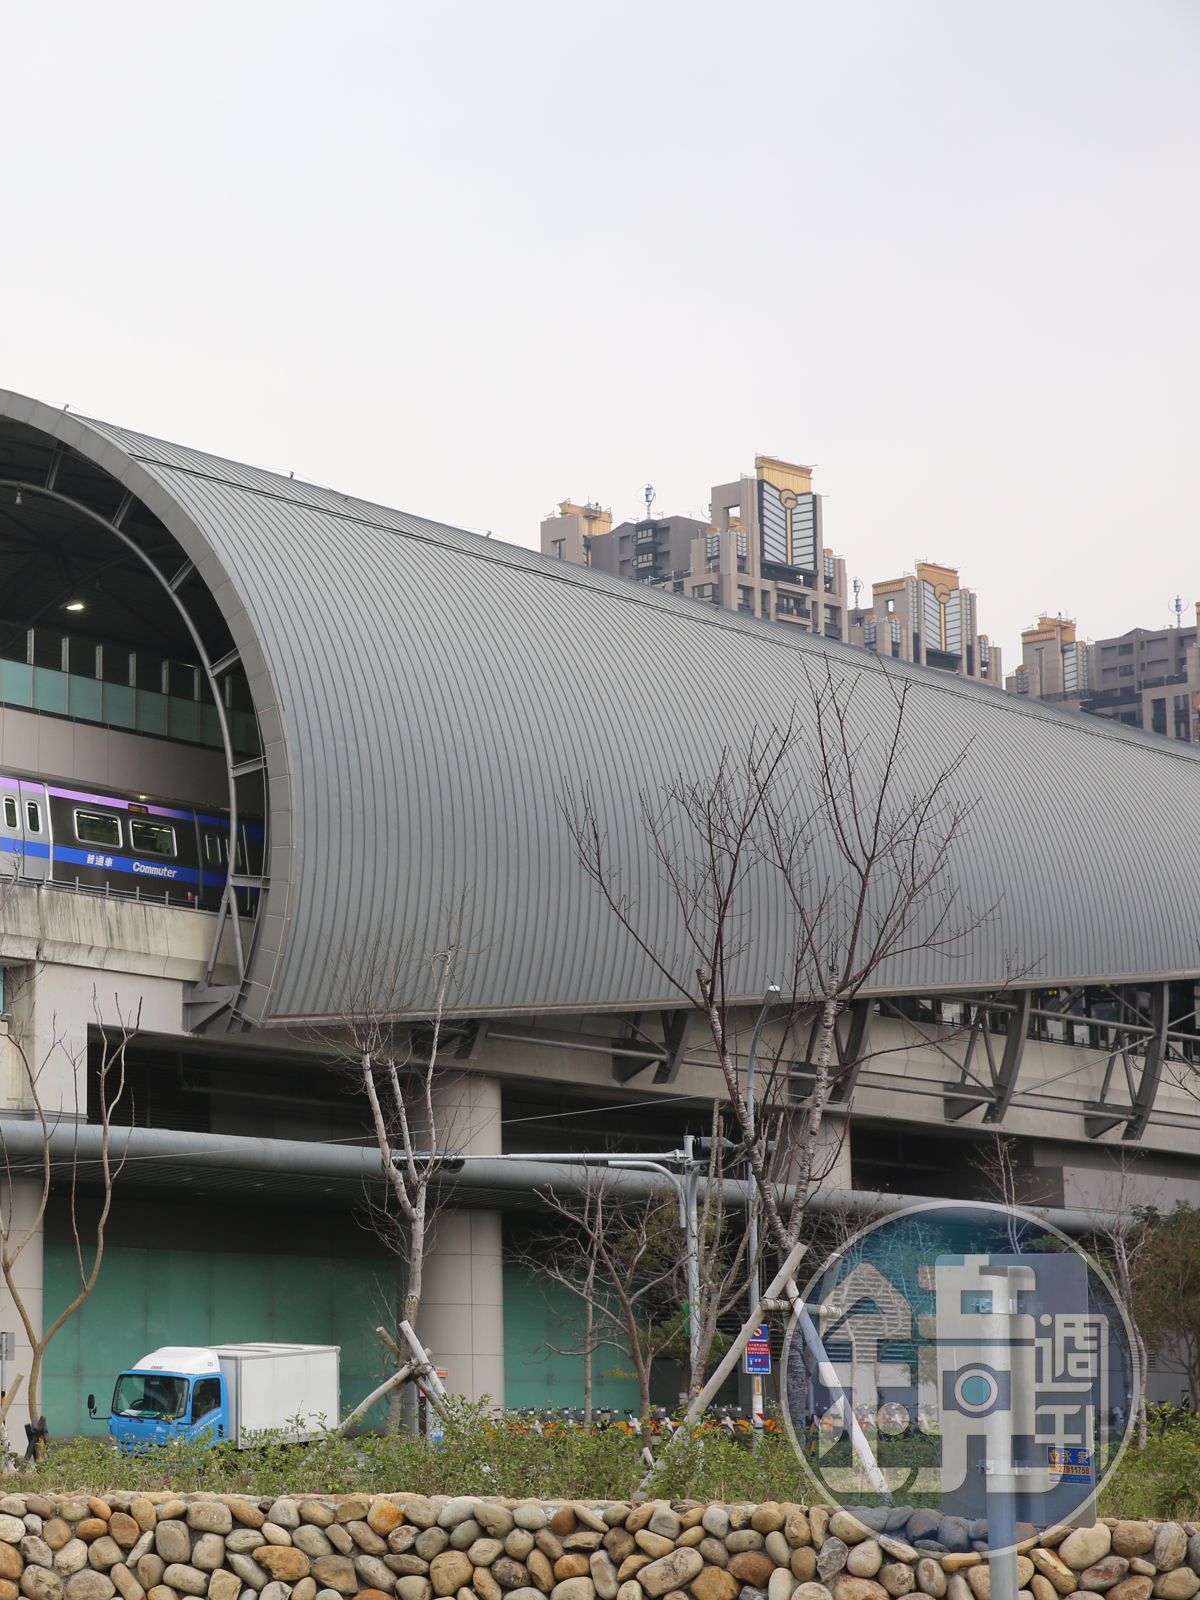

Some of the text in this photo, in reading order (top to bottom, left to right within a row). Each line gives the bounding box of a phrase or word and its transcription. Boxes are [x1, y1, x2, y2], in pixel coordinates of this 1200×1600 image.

[86, 854, 113, 867] 普通車
[132, 862, 177, 878] Commuter
